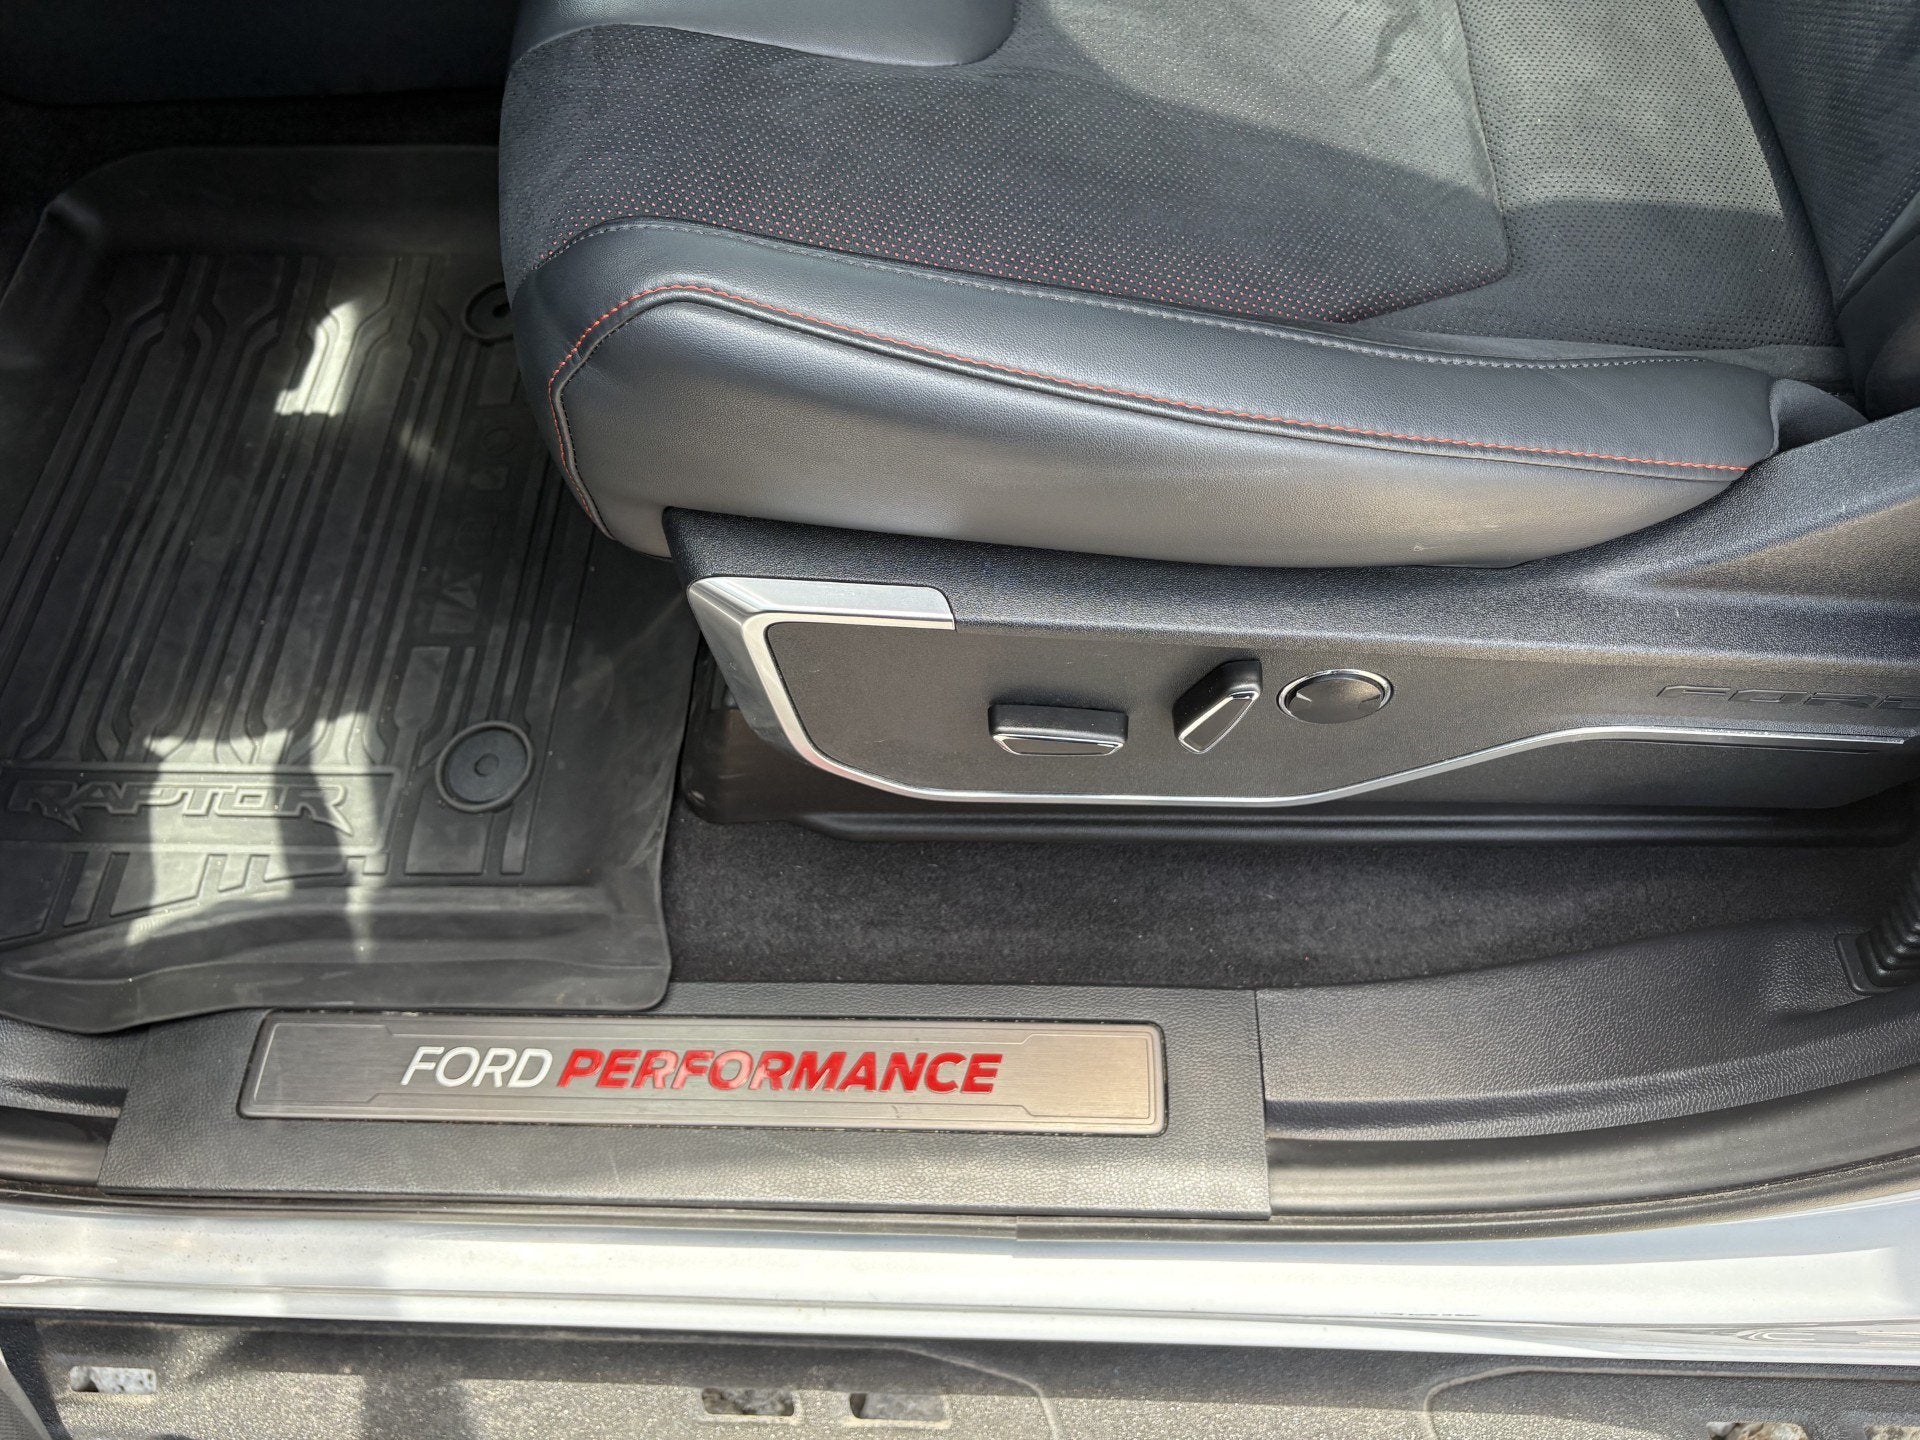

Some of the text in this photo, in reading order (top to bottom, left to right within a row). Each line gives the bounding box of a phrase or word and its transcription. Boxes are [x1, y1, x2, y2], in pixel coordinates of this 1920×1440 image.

[7, 780, 354, 836] RAPTOR
[401, 1046, 1003, 1093] FORD PERFORMANCE
